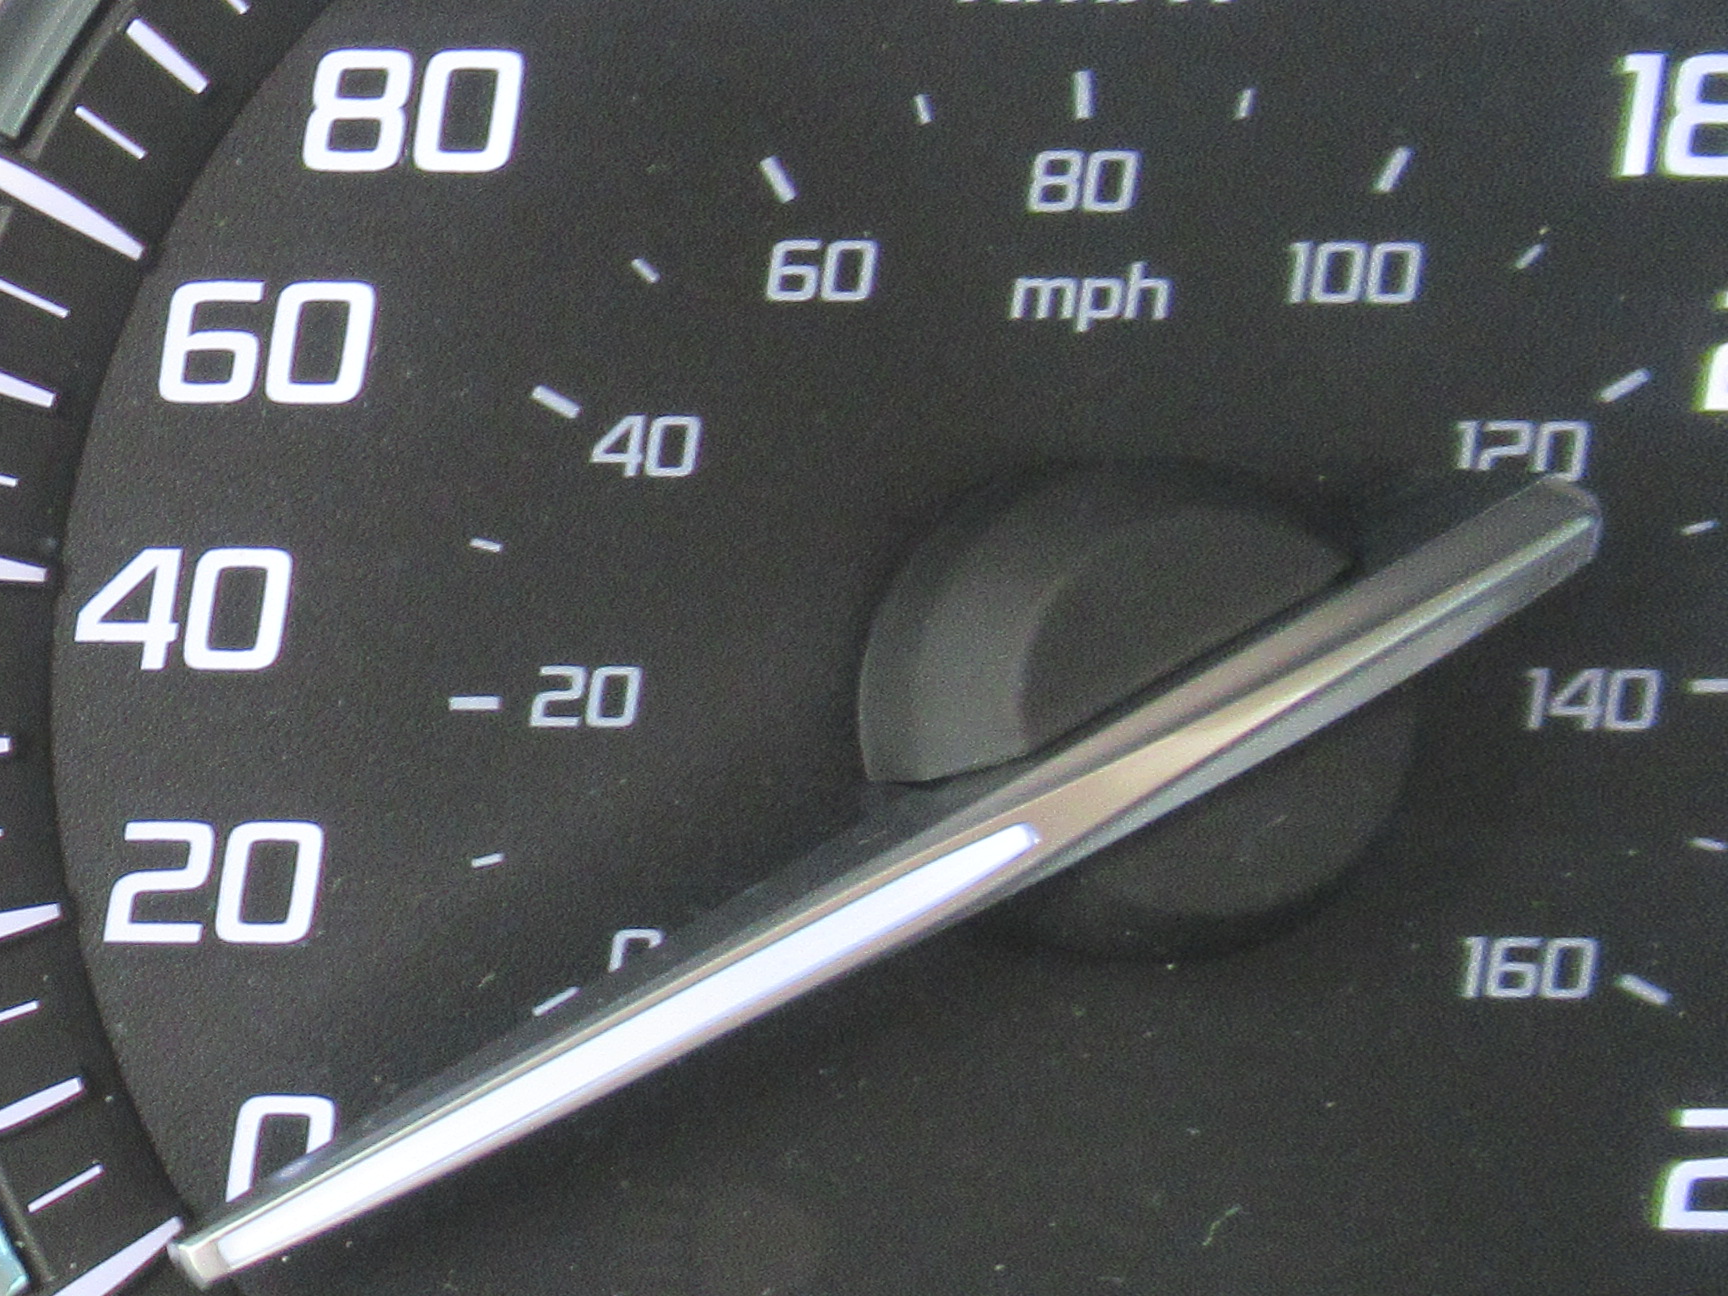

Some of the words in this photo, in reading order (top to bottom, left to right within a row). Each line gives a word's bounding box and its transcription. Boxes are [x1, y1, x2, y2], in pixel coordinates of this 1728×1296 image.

[301, 48, 524, 174] 80
[1026, 149, 1140, 214] 80
[764, 238, 879, 303] 60
[1008, 260, 1172, 334] mph
[1287, 240, 1424, 306] 100
[157, 279, 377, 405] 60
[589, 414, 703, 479] 40
[1455, 419, 1591, 481] 120
[73, 547, 294, 672] 40
[528, 664, 644, 729] 20
[1525, 667, 1663, 733] 140
[102, 820, 326, 945] 20
[1460, 935, 1599, 1001] 160
